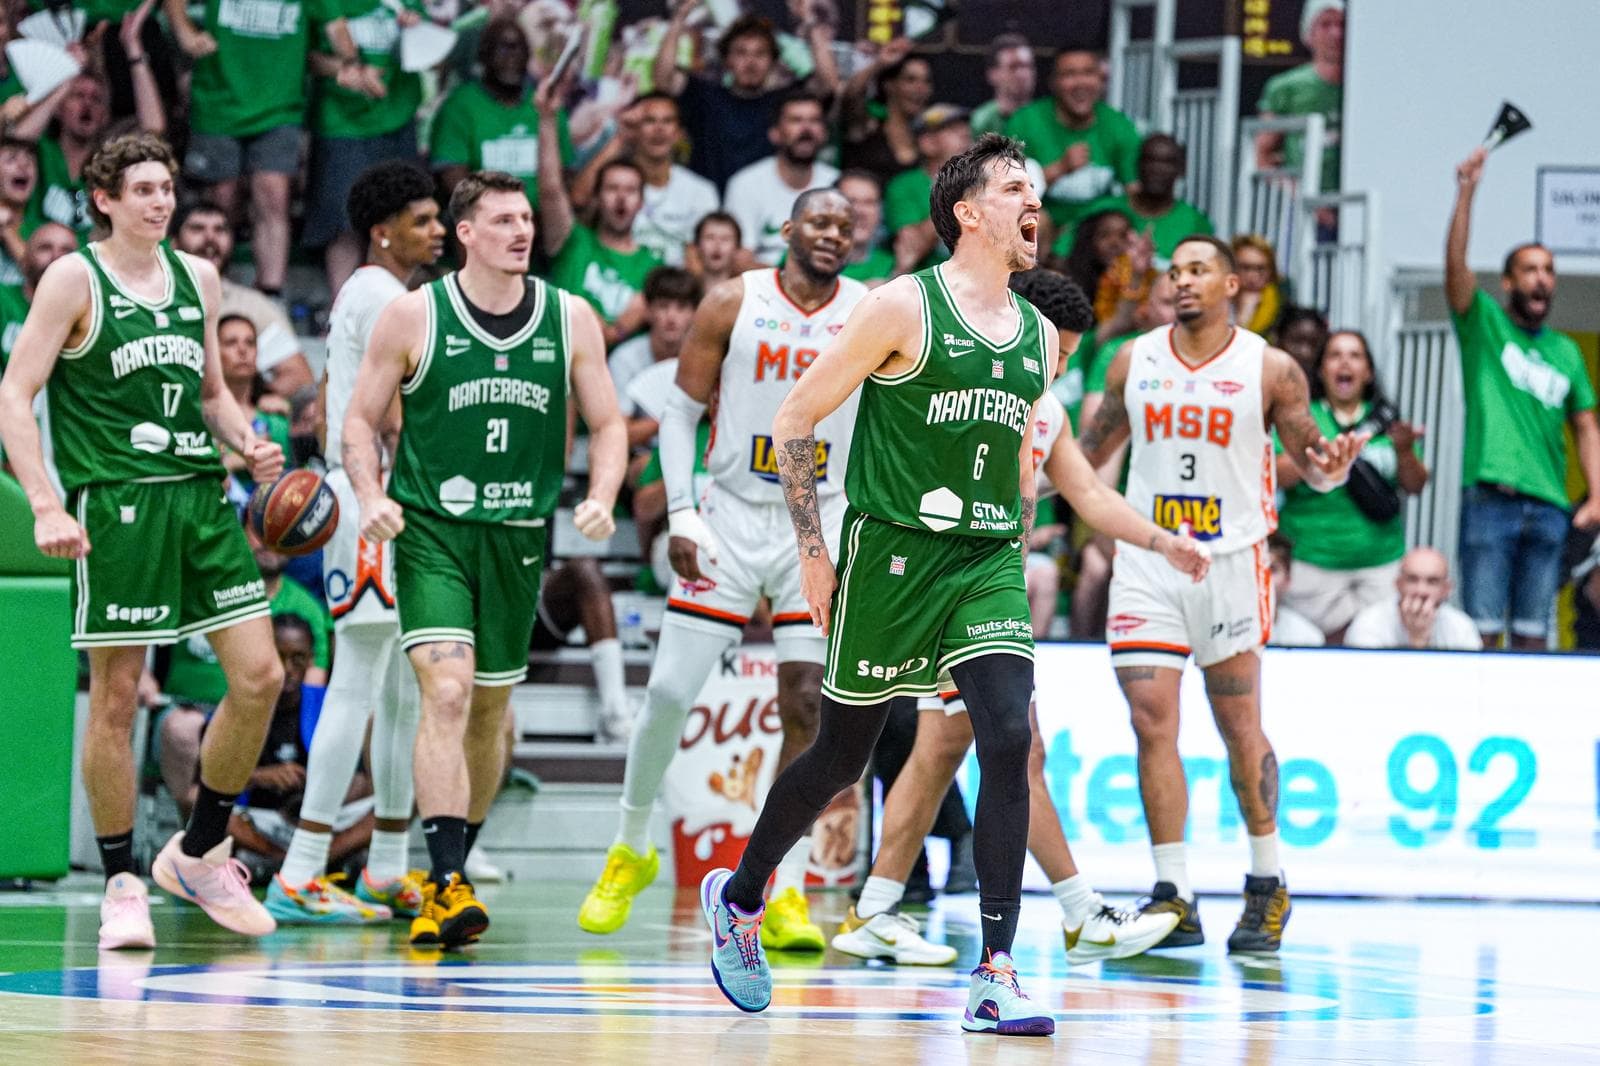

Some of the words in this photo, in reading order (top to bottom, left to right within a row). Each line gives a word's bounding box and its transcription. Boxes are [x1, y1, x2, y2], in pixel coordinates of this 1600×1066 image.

[110, 334, 205, 379] NANTERRE9
[753, 341, 819, 383] MS
[161, 382, 184, 418] 17
[448, 377, 550, 414] NANTERRE92
[926, 387, 1032, 438] NANTERRE9
[485, 418, 509, 453] 21
[1143, 402, 1234, 449] MSB
[972, 443, 990, 481] 6
[1179, 453, 1196, 481] 3
[483, 481, 533, 499] GTM
[972, 501, 1009, 520] GTM
[1387, 731, 1537, 849] 92
